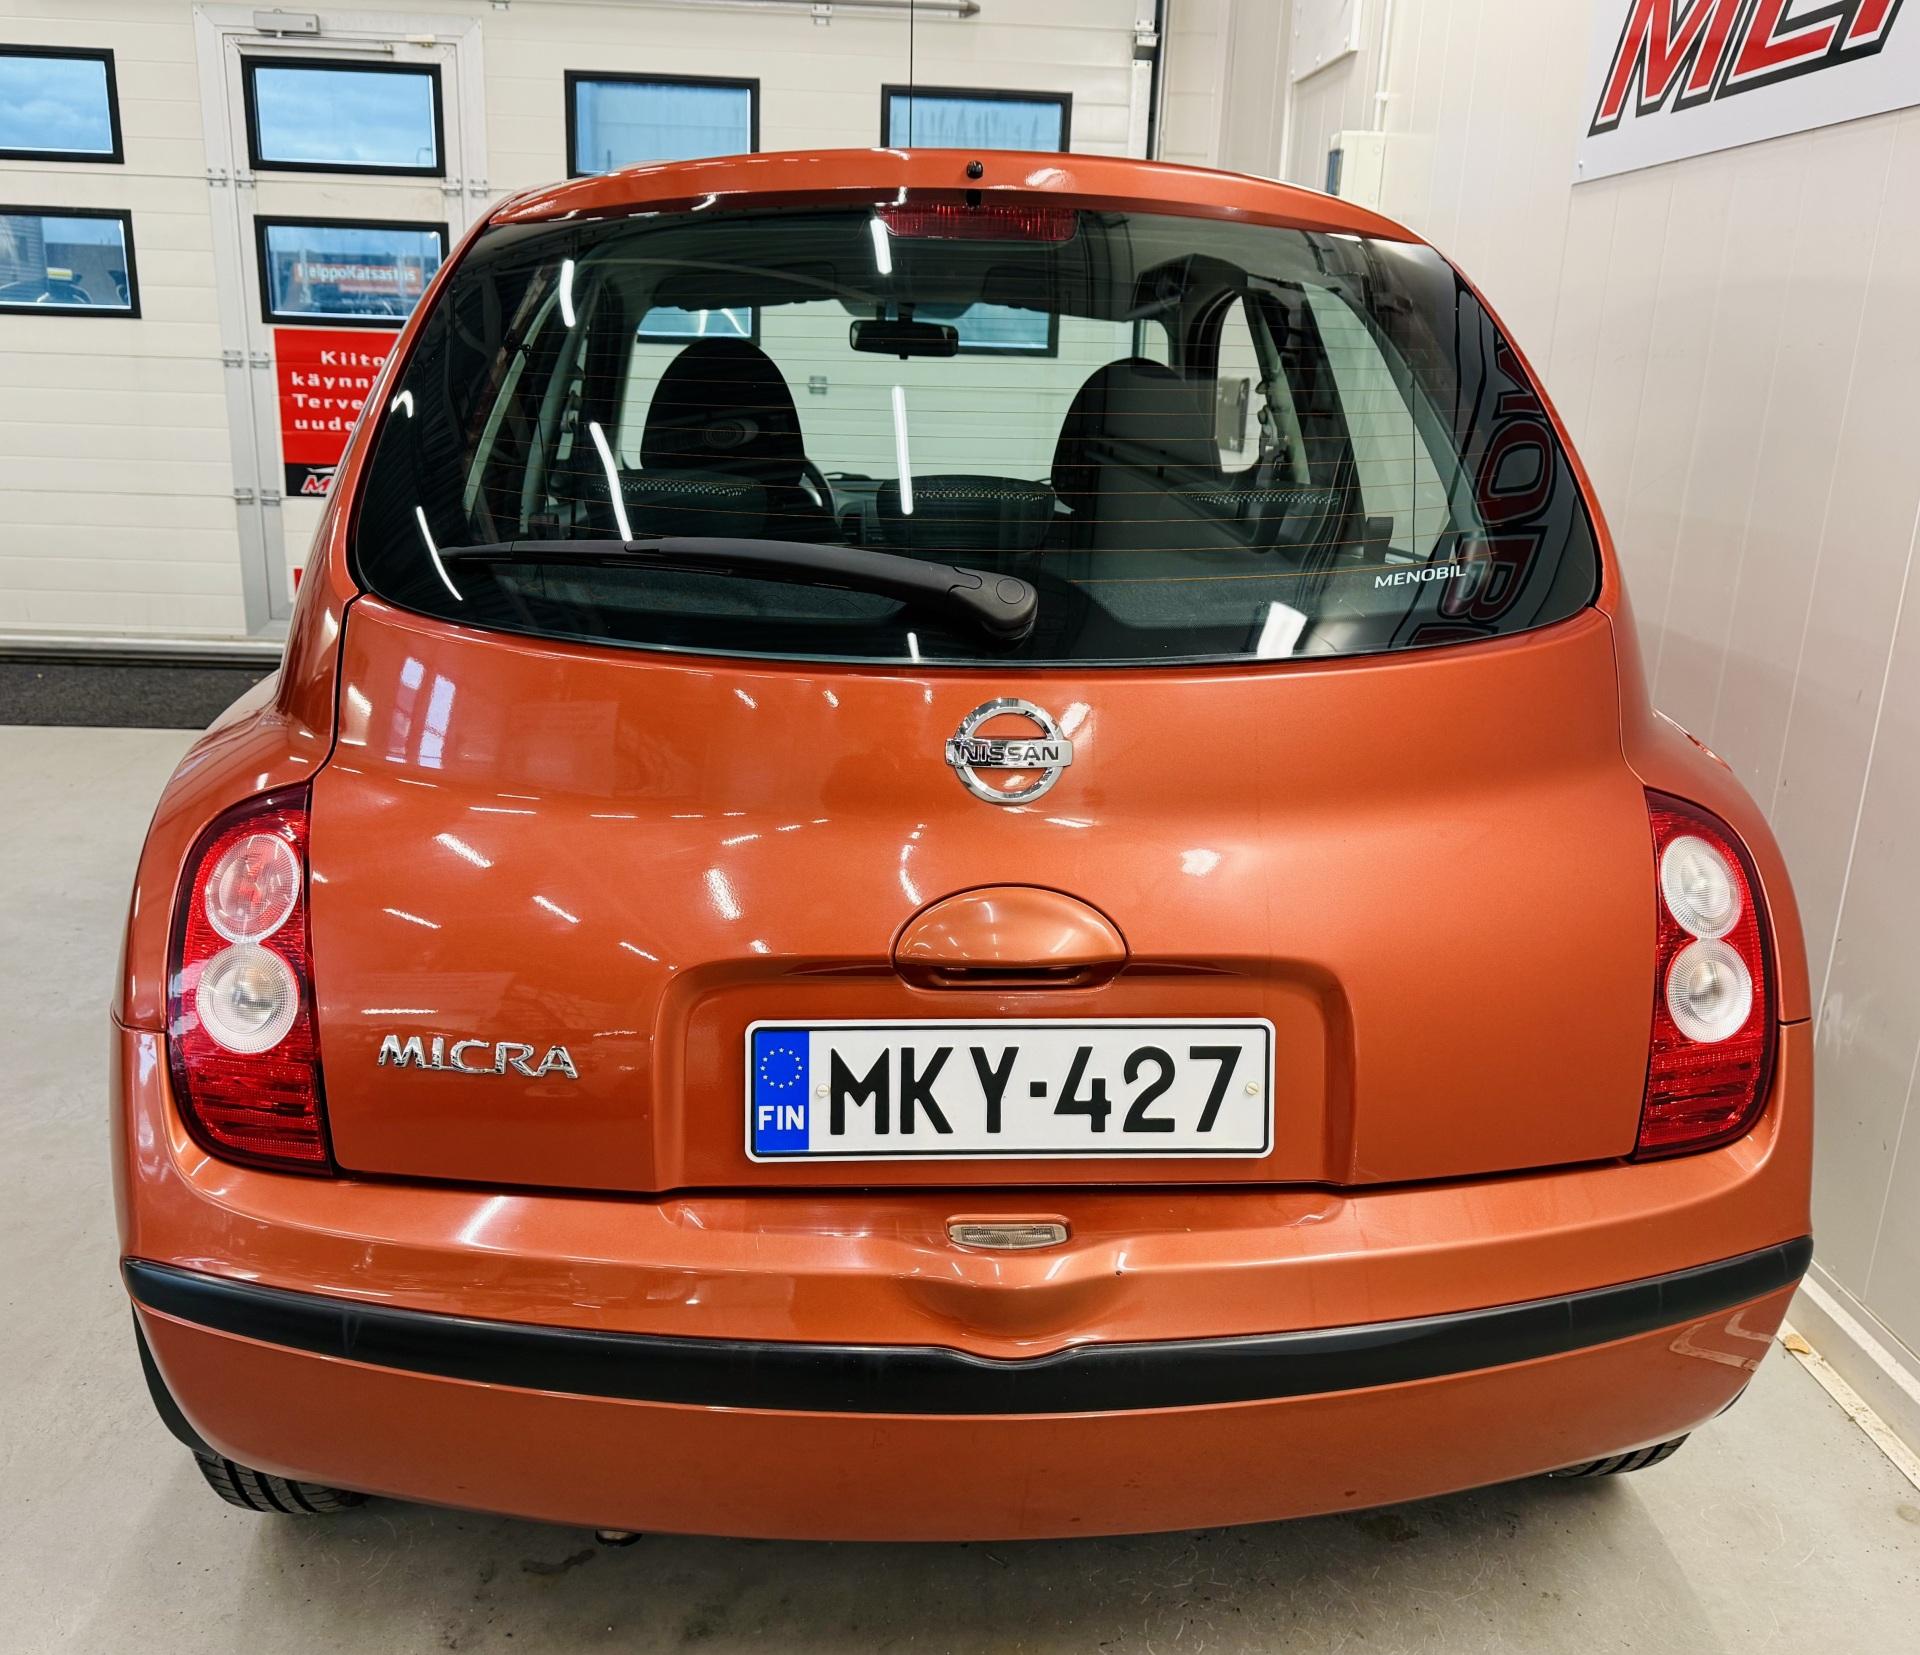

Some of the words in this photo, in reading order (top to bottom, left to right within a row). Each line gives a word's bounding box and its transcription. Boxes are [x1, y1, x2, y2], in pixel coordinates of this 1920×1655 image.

[321, 350, 386, 367] Kiito
[291, 393, 364, 410] Terve
[294, 416, 356, 432] uude
[1374, 564, 1467, 589] MENOBIL
[959, 744, 1060, 763] NISSAN
[377, 1034, 579, 1079] MICRA
[829, 1045, 1243, 1136] MKY-427
[757, 1104, 805, 1131] FIN
